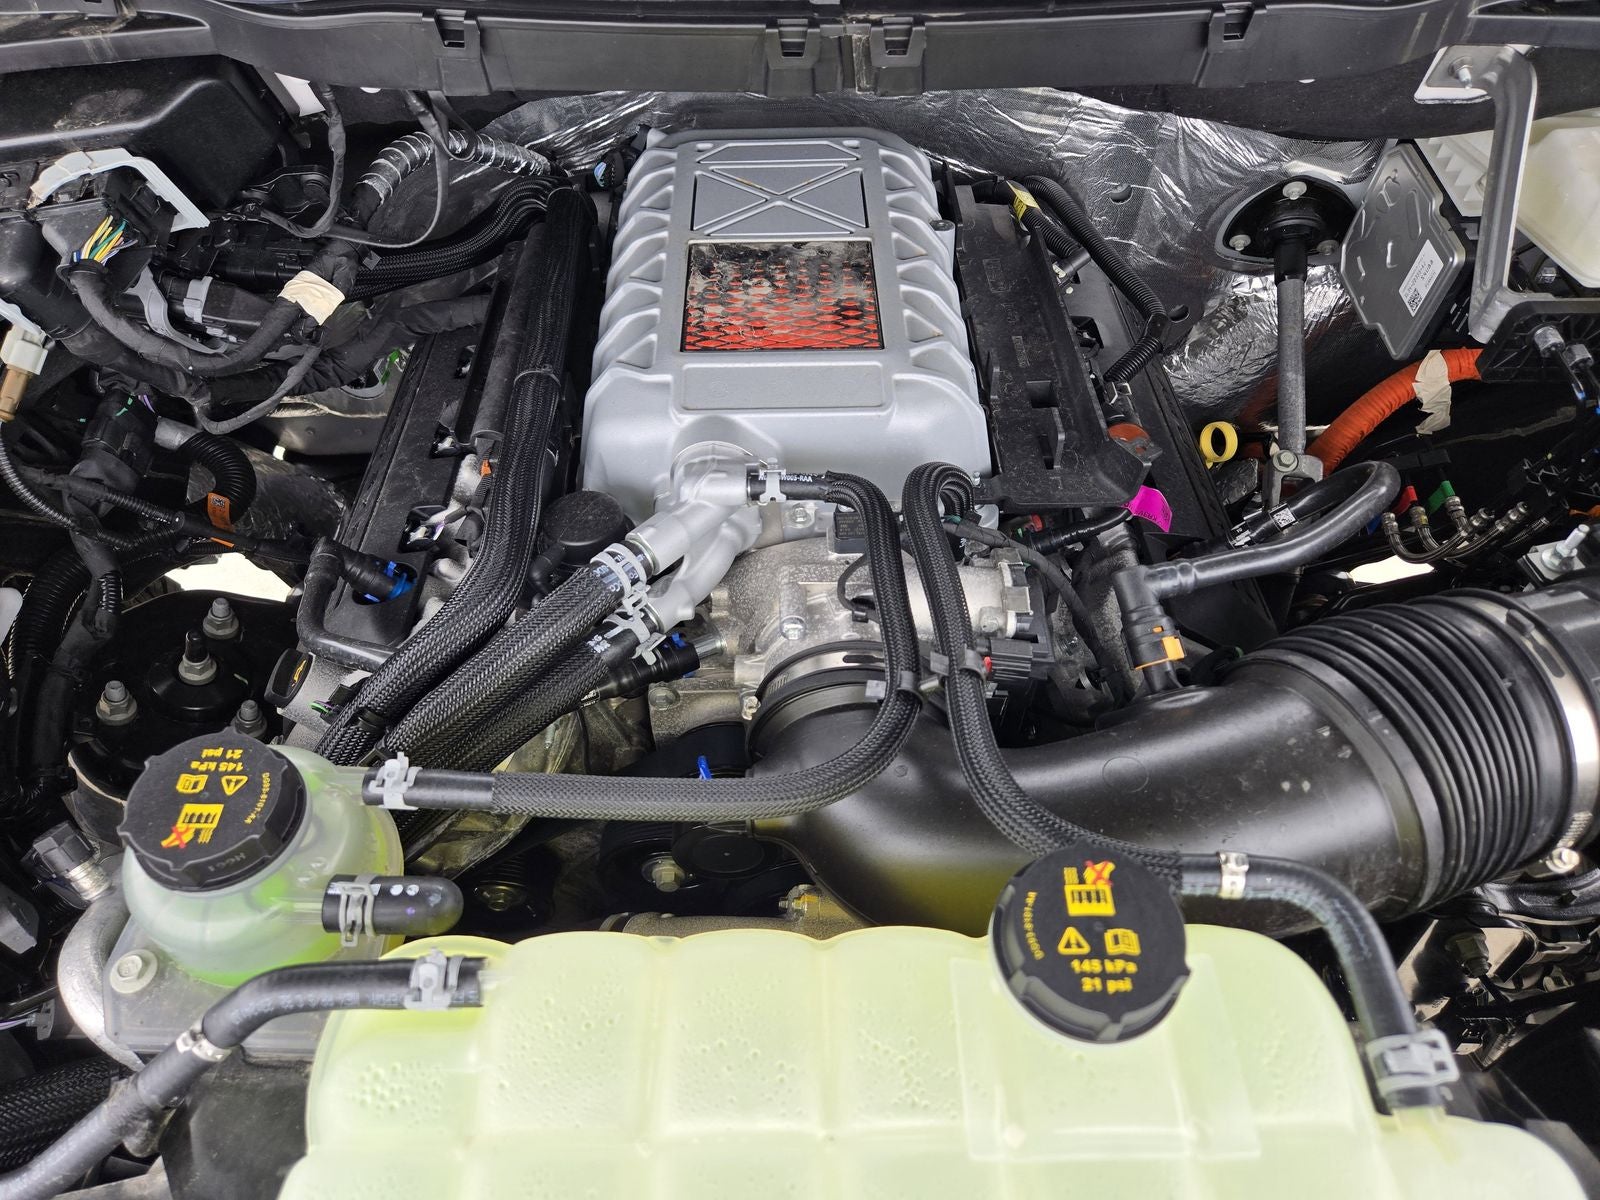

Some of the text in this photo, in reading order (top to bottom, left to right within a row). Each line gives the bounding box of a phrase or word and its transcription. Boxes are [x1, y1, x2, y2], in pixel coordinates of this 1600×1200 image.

[200, 747, 243, 759] 21 psi
[190, 760, 245, 772] 145 kPa
[1070, 959, 1138, 974] 145 kPa
[1081, 977, 1133, 995] 21 psi
